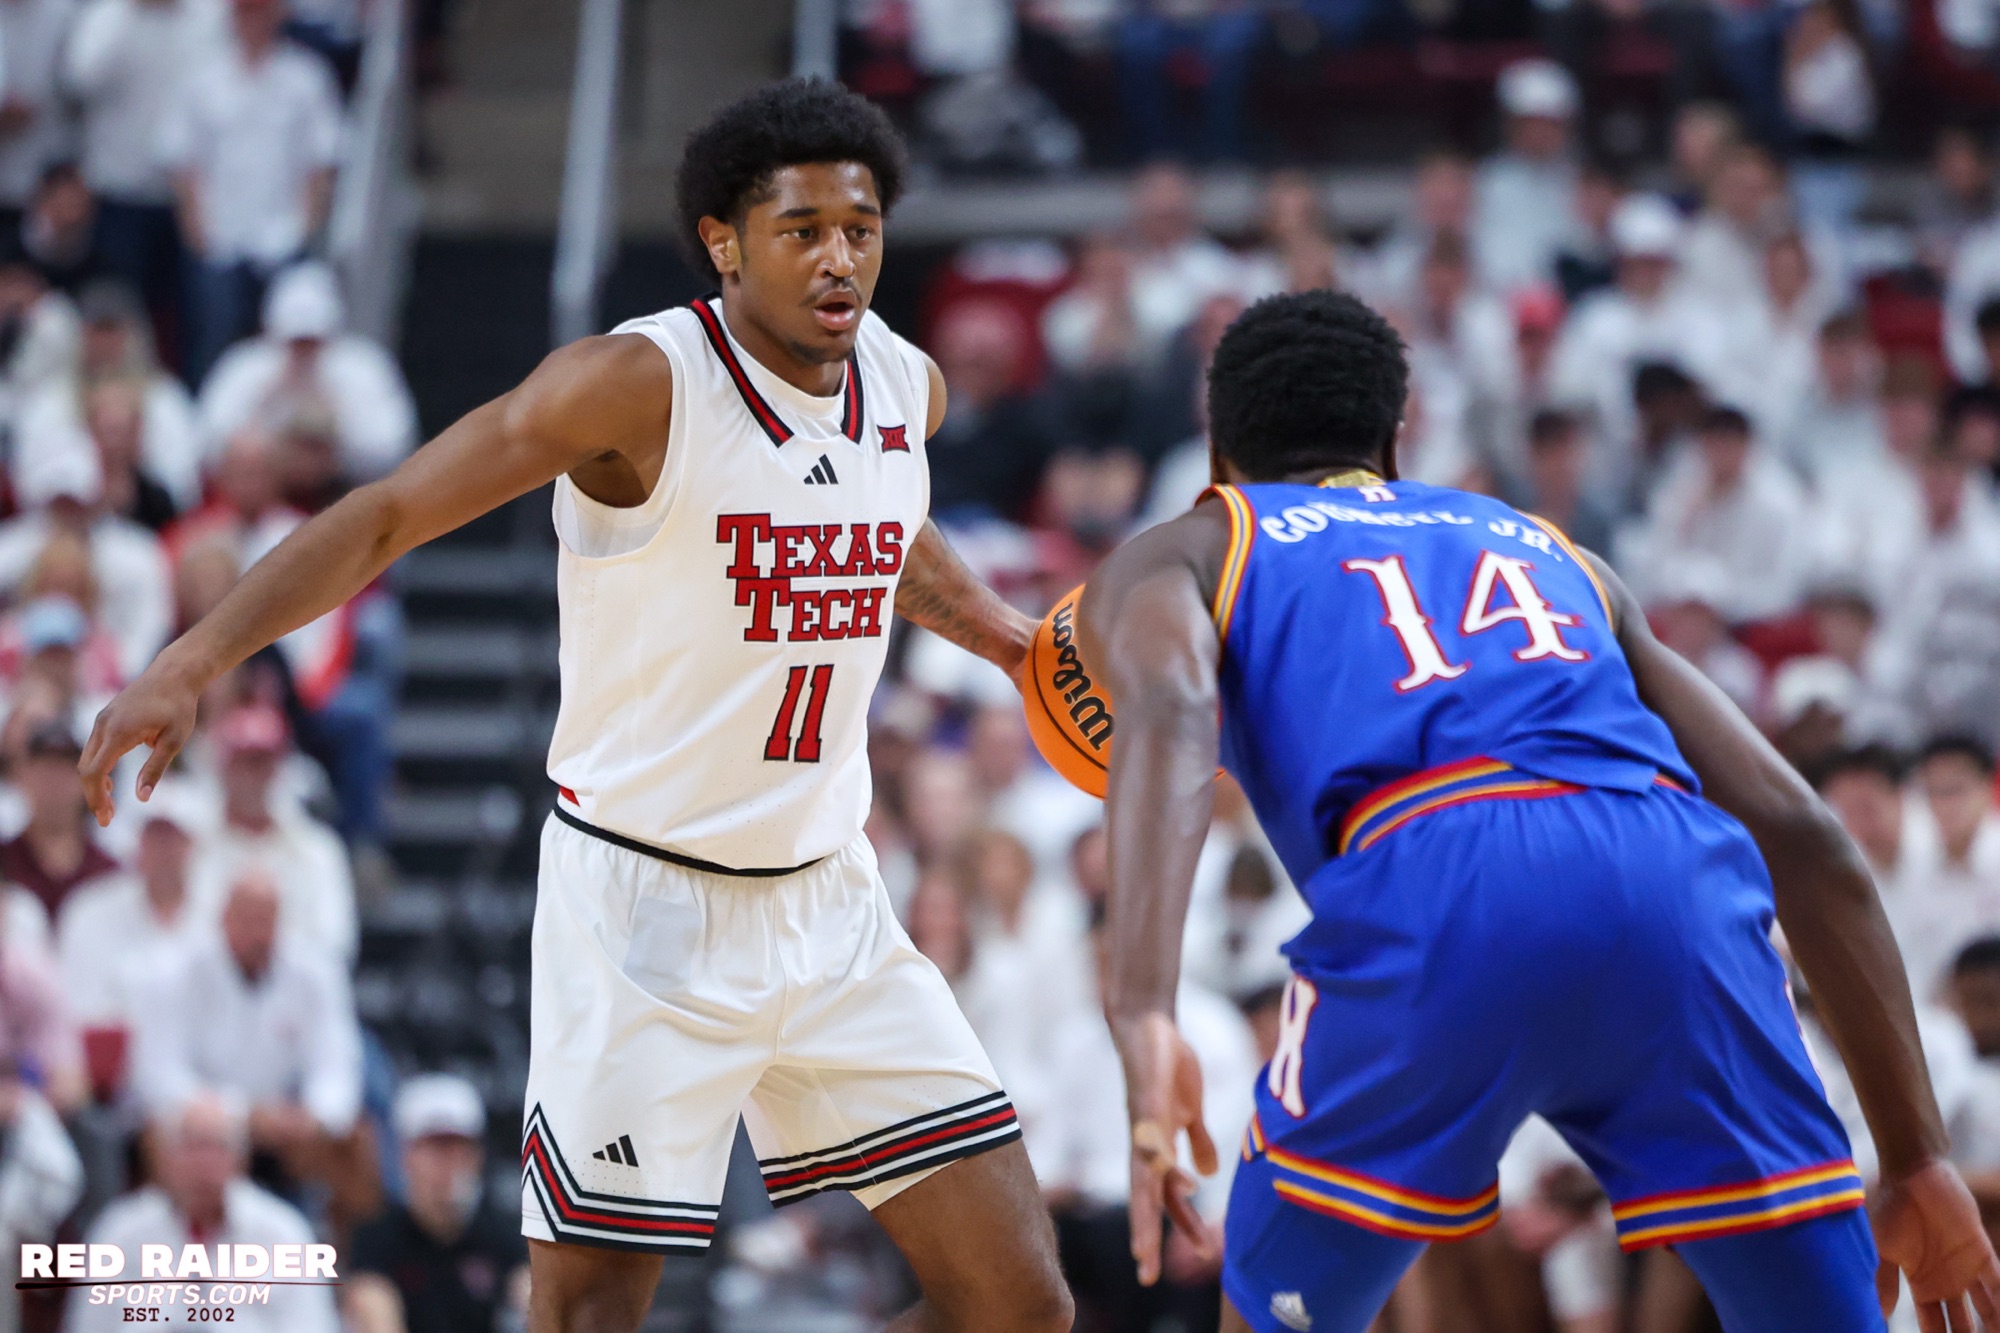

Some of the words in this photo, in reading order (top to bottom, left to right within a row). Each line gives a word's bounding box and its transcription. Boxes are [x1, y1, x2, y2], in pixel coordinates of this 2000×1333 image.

[716, 512, 904, 580] TEXAS
[734, 577, 888, 642] TECH
[1340, 549, 1592, 695] 14
[763, 663, 835, 763] 11
[1052, 602, 1116, 752] Wilson
